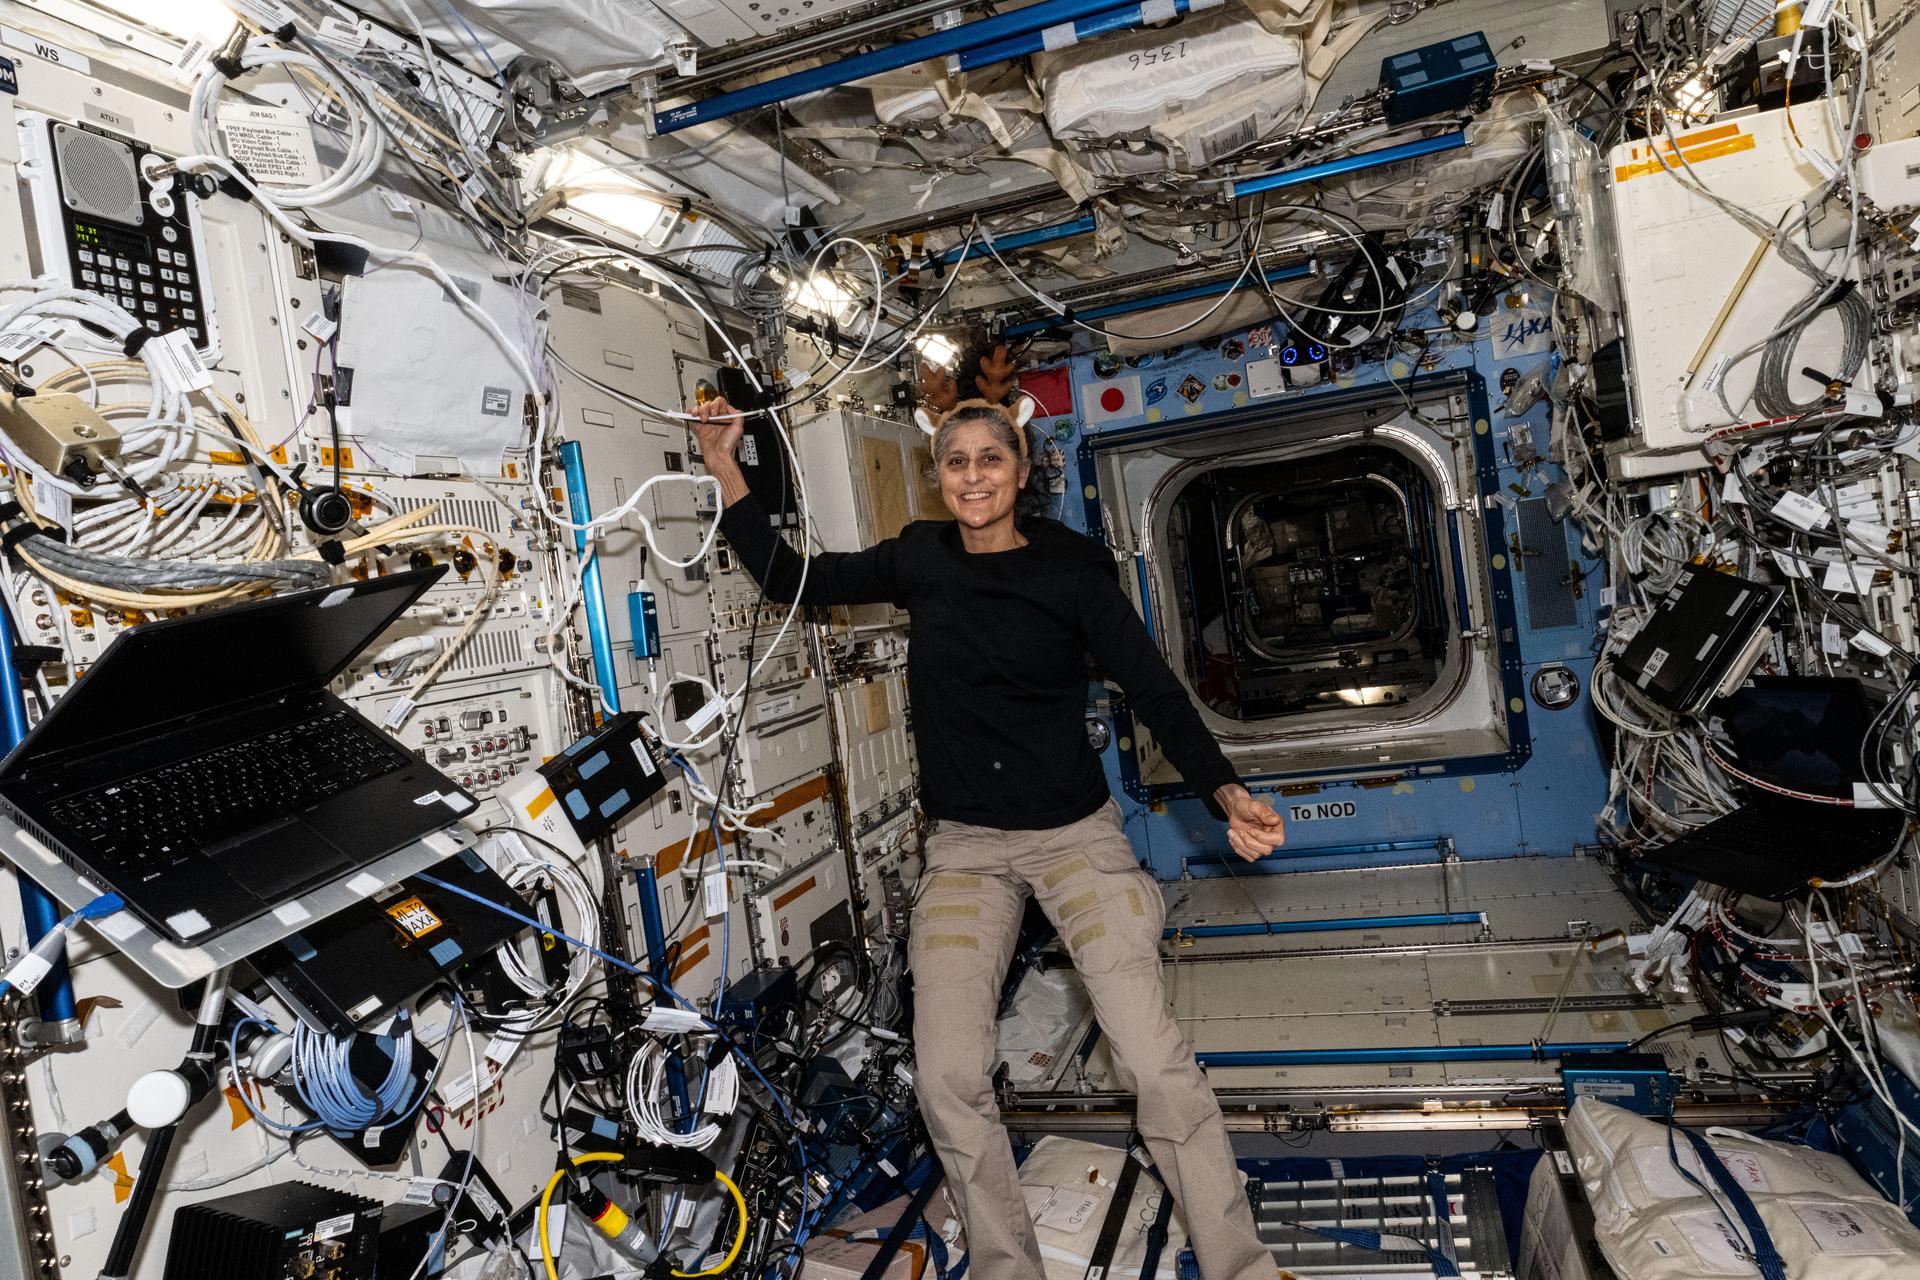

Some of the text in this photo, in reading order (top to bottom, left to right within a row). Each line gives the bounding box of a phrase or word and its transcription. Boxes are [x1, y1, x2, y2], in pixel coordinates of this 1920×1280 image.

[34, 42, 59, 62] WS
[1128, 41, 1188, 71] 1356
[100, 112, 114, 122] ATU
[251, 151, 271, 159] Payload
[1500, 316, 1552, 352] JAXA
[1290, 802, 1356, 820] To NOD
[394, 902, 425, 922] MLT2
[19, 980, 29, 988] P1
